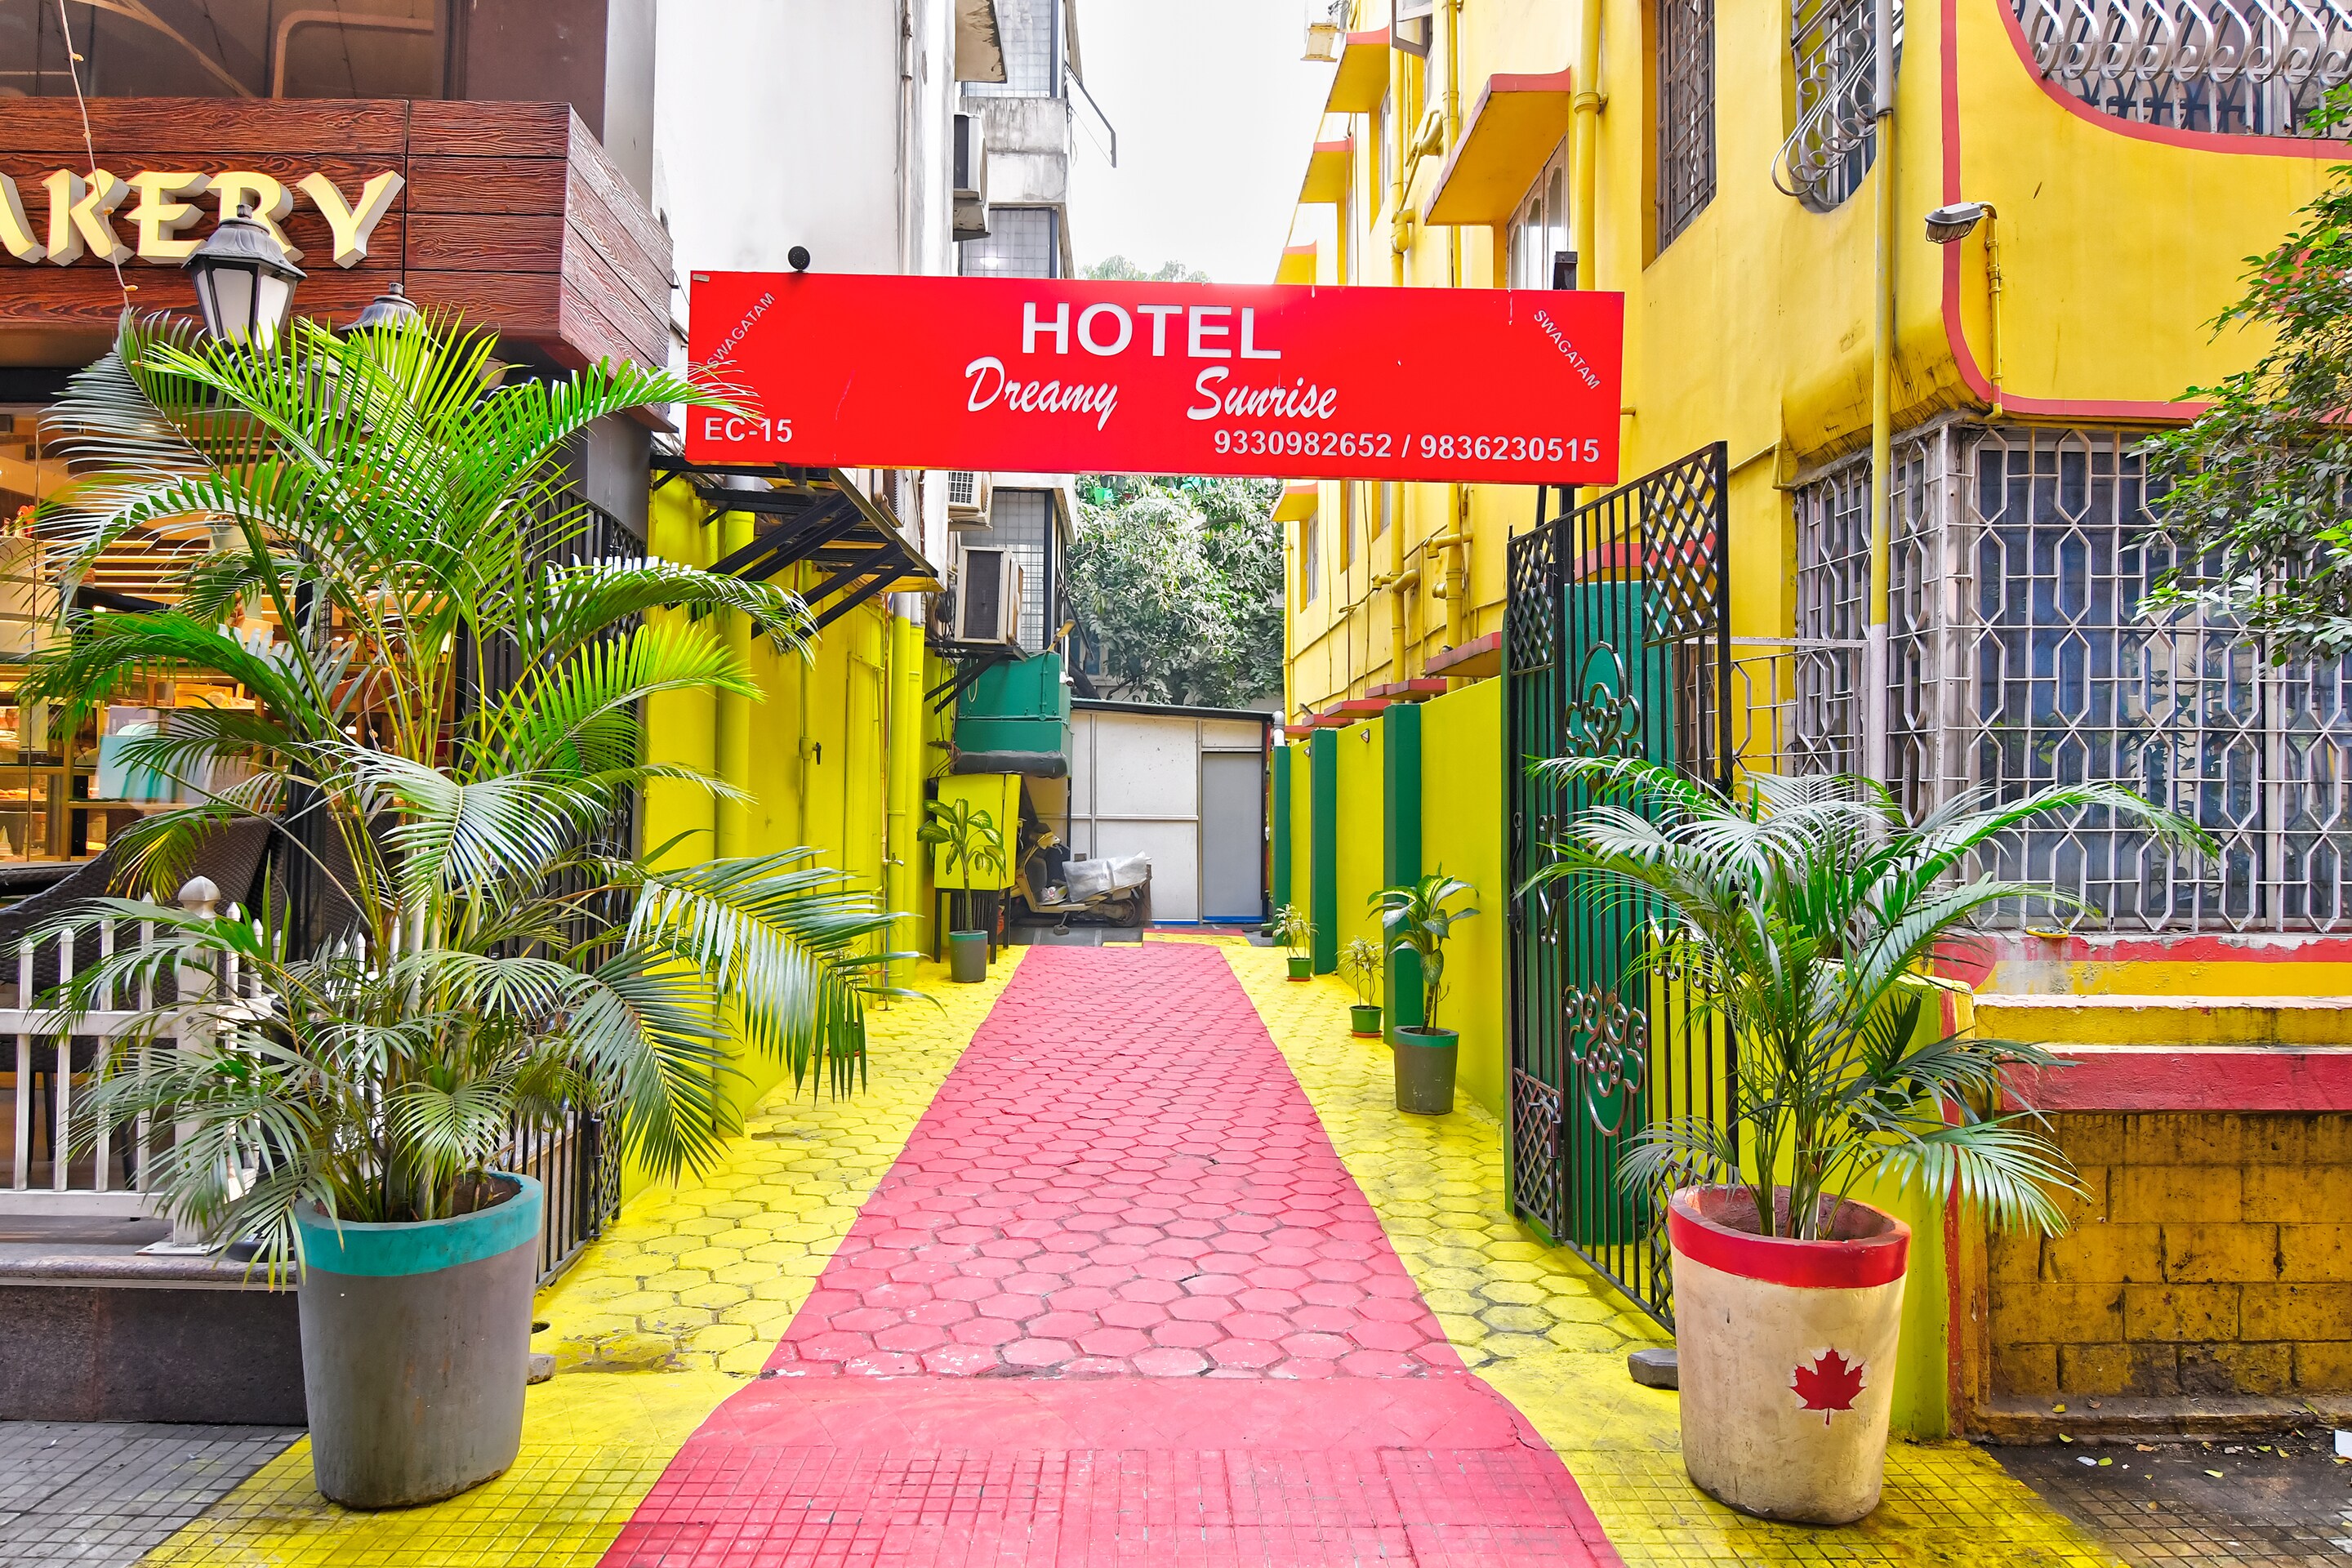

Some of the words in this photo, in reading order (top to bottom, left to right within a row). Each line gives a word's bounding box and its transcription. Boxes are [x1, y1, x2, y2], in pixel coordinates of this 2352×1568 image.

[706, 292, 775, 369] SWAGATAM
[1022, 301, 1281, 359] HOTEL
[1534, 310, 1601, 390] SWAGATAM
[964, 356, 1119, 431] Dreamy
[1187, 366, 1337, 421] Sunrise
[705, 416, 793, 443] EC-15
[1214, 430, 1392, 457] 9330982652
[1401, 434, 1411, 459] /
[1420, 434, 1599, 463] 9836230515
